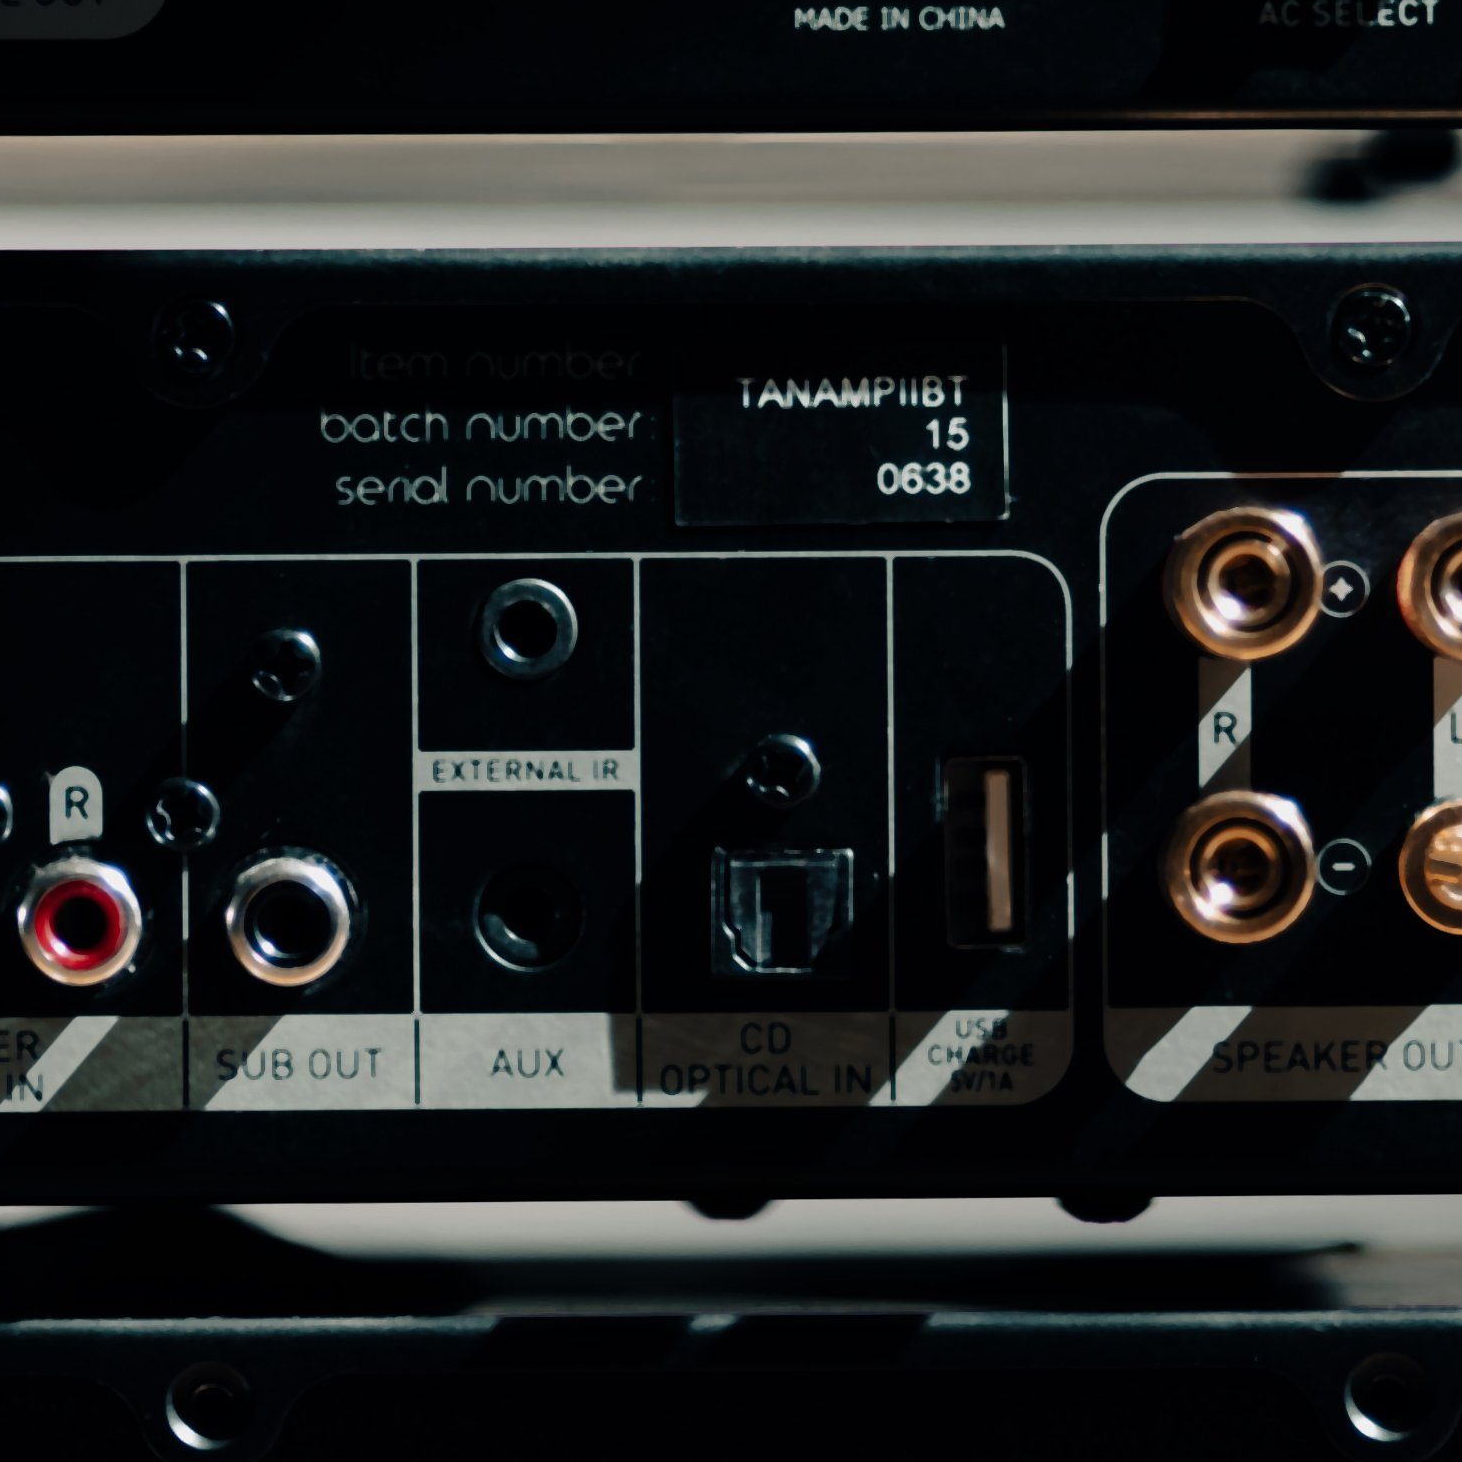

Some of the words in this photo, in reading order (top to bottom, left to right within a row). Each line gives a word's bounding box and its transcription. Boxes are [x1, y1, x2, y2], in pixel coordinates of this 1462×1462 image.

[794, 6, 870, 31] MADE
[881, 6, 910, 30] IN
[918, 6, 1006, 31] CHINA
[1258, 0, 1302, 27] AC
[737, 376, 968, 408] TANAMPIIBT
[320, 406, 449, 443] batch
[926, 417, 969, 451] 15
[336, 464, 449, 506] serial
[876, 461, 971, 496] 0638
[1212, 711, 1238, 744] R
[433, 760, 581, 782] EXTERNAL
[592, 759, 621, 781] IR
[64, 785, 90, 819] R
[740, 1022, 792, 1056] CD
[955, 1018, 1008, 1040] USB
[217, 1049, 293, 1081] SUB
[309, 1048, 382, 1080] OUT
[490, 1049, 565, 1079] AUX
[927, 1043, 1035, 1066] CHARGE
[1212, 1041, 1386, 1075] SPEAKER
[5, 1072, 44, 1101] IN
[659, 1064, 820, 1097] OPTICAL
[834, 1064, 872, 1094] IN
